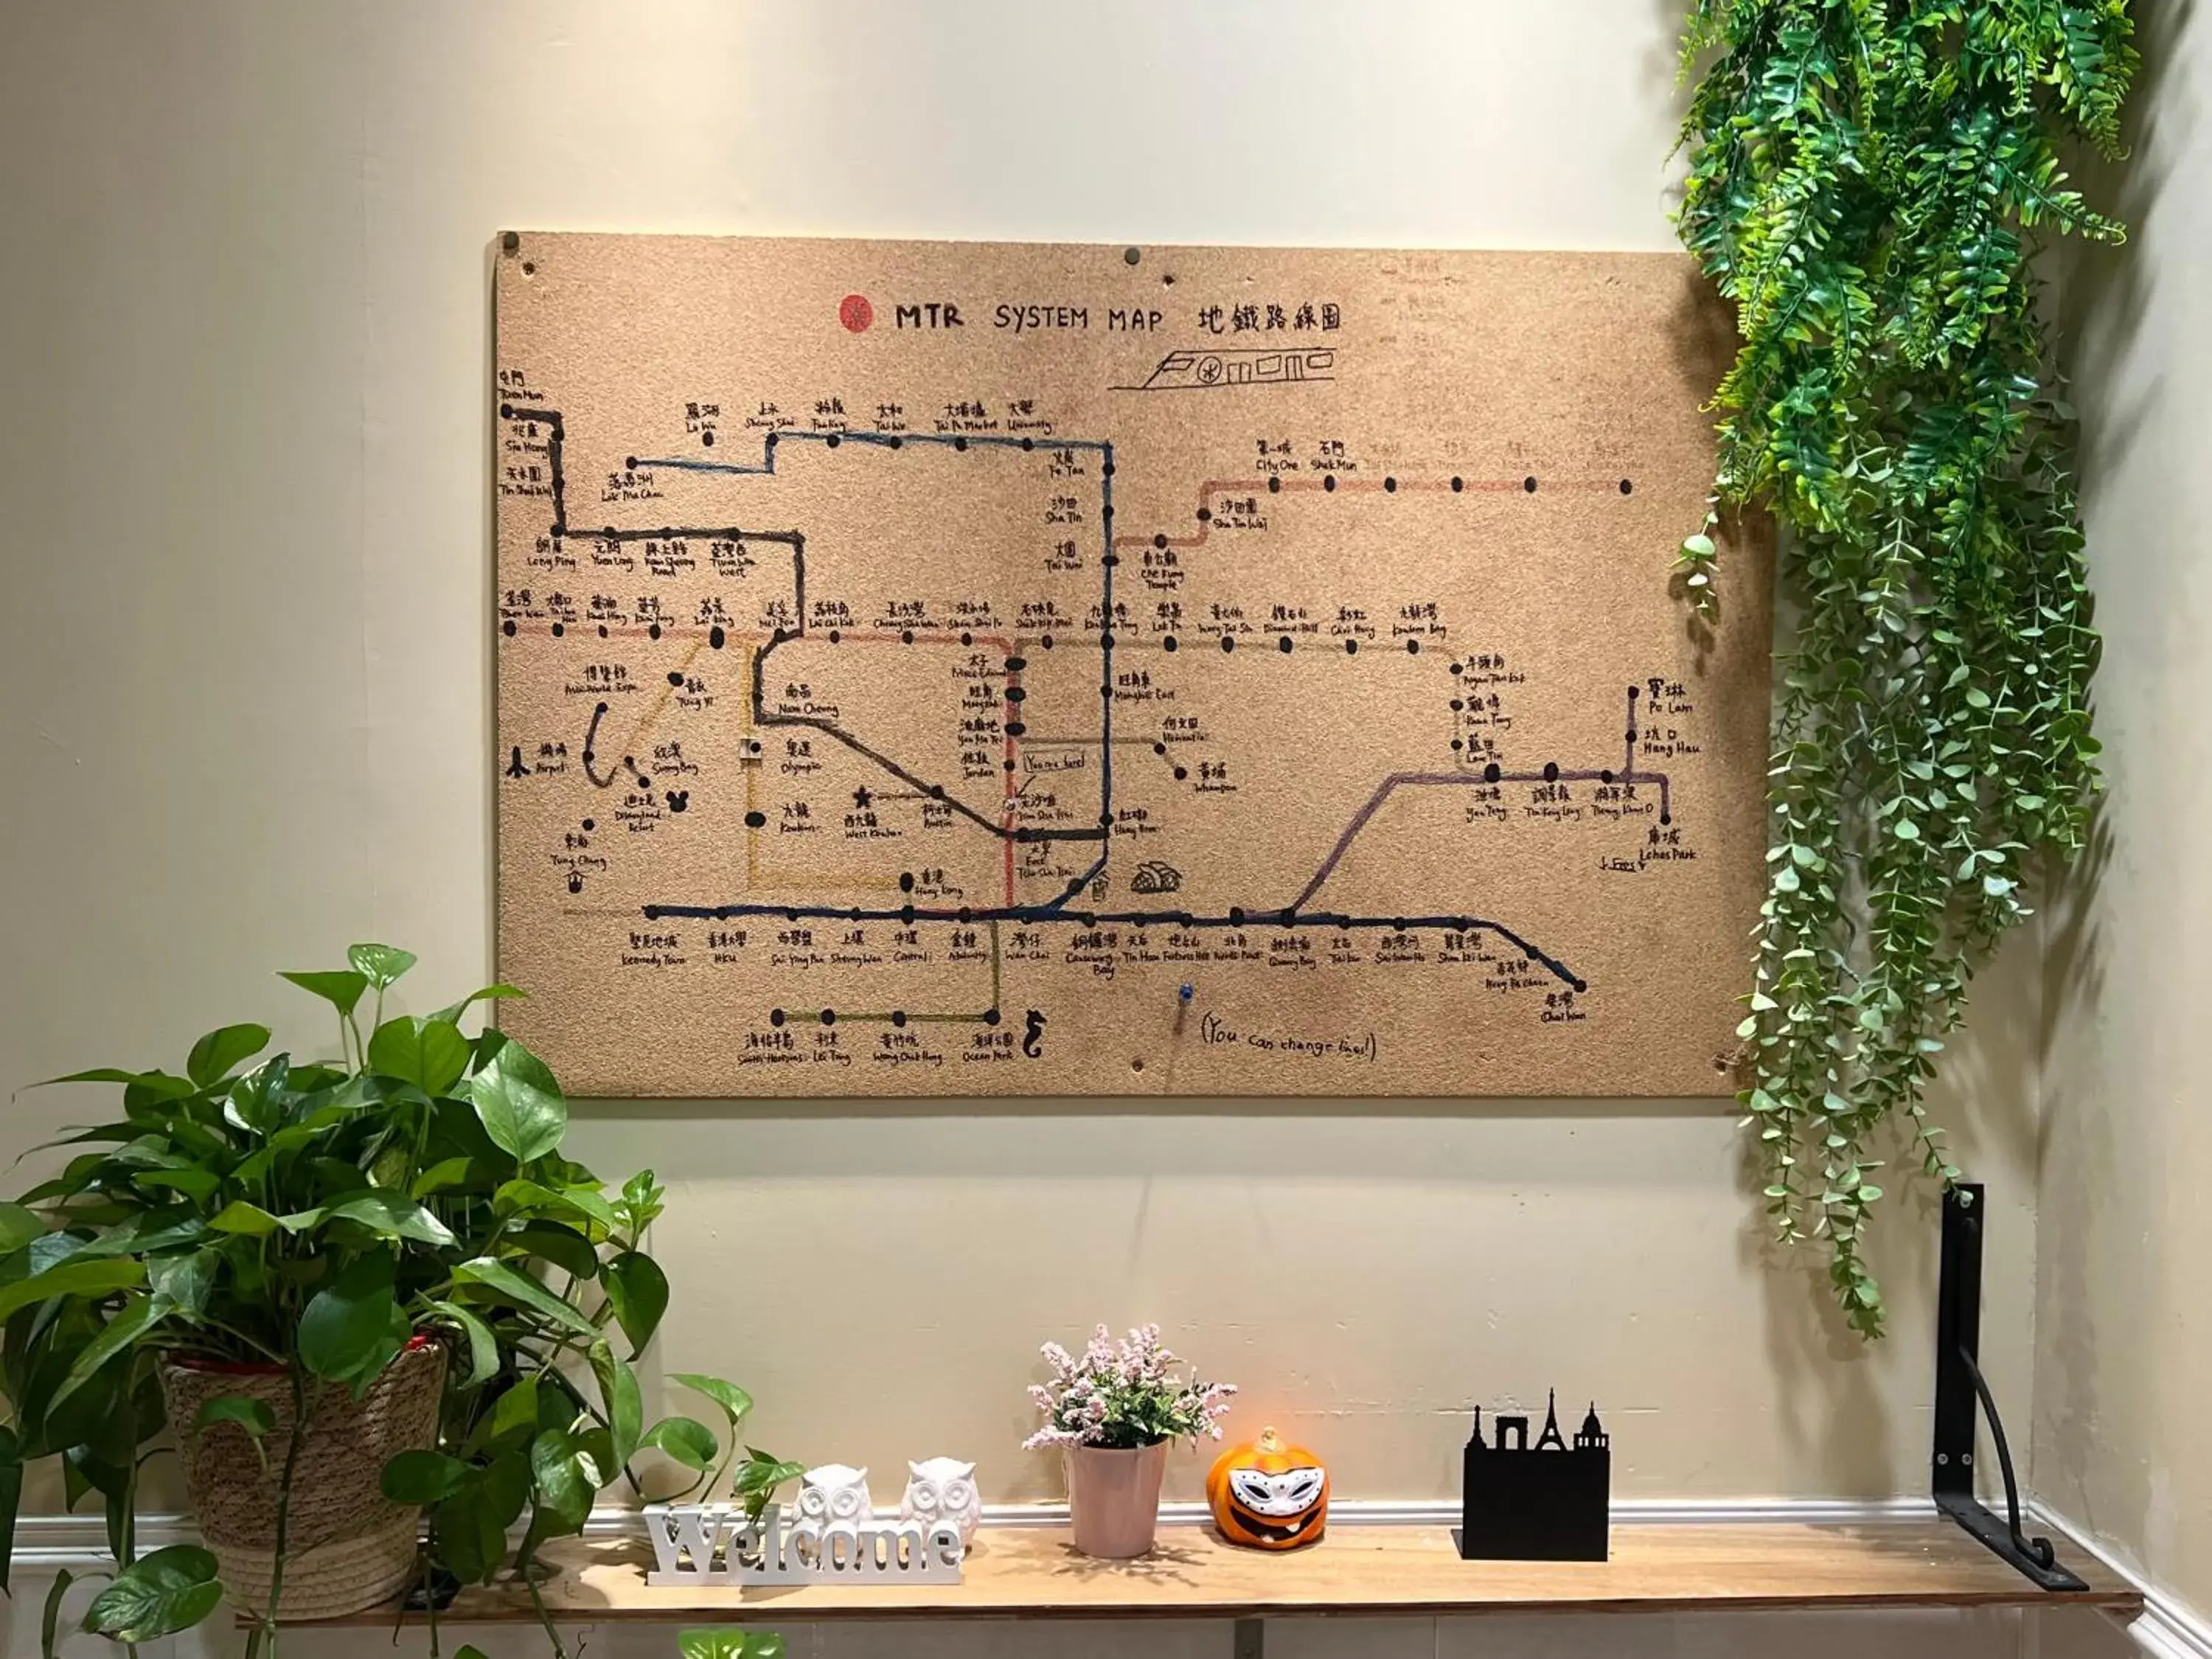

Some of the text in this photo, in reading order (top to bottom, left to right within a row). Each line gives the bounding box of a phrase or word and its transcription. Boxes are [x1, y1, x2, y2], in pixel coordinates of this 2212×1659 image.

[896, 304, 1163, 333] MTR SYSTEM MAP
[1199, 302, 1341, 334] 地鐵路線圖
[641, 1504, 961, 1582] Welcome
